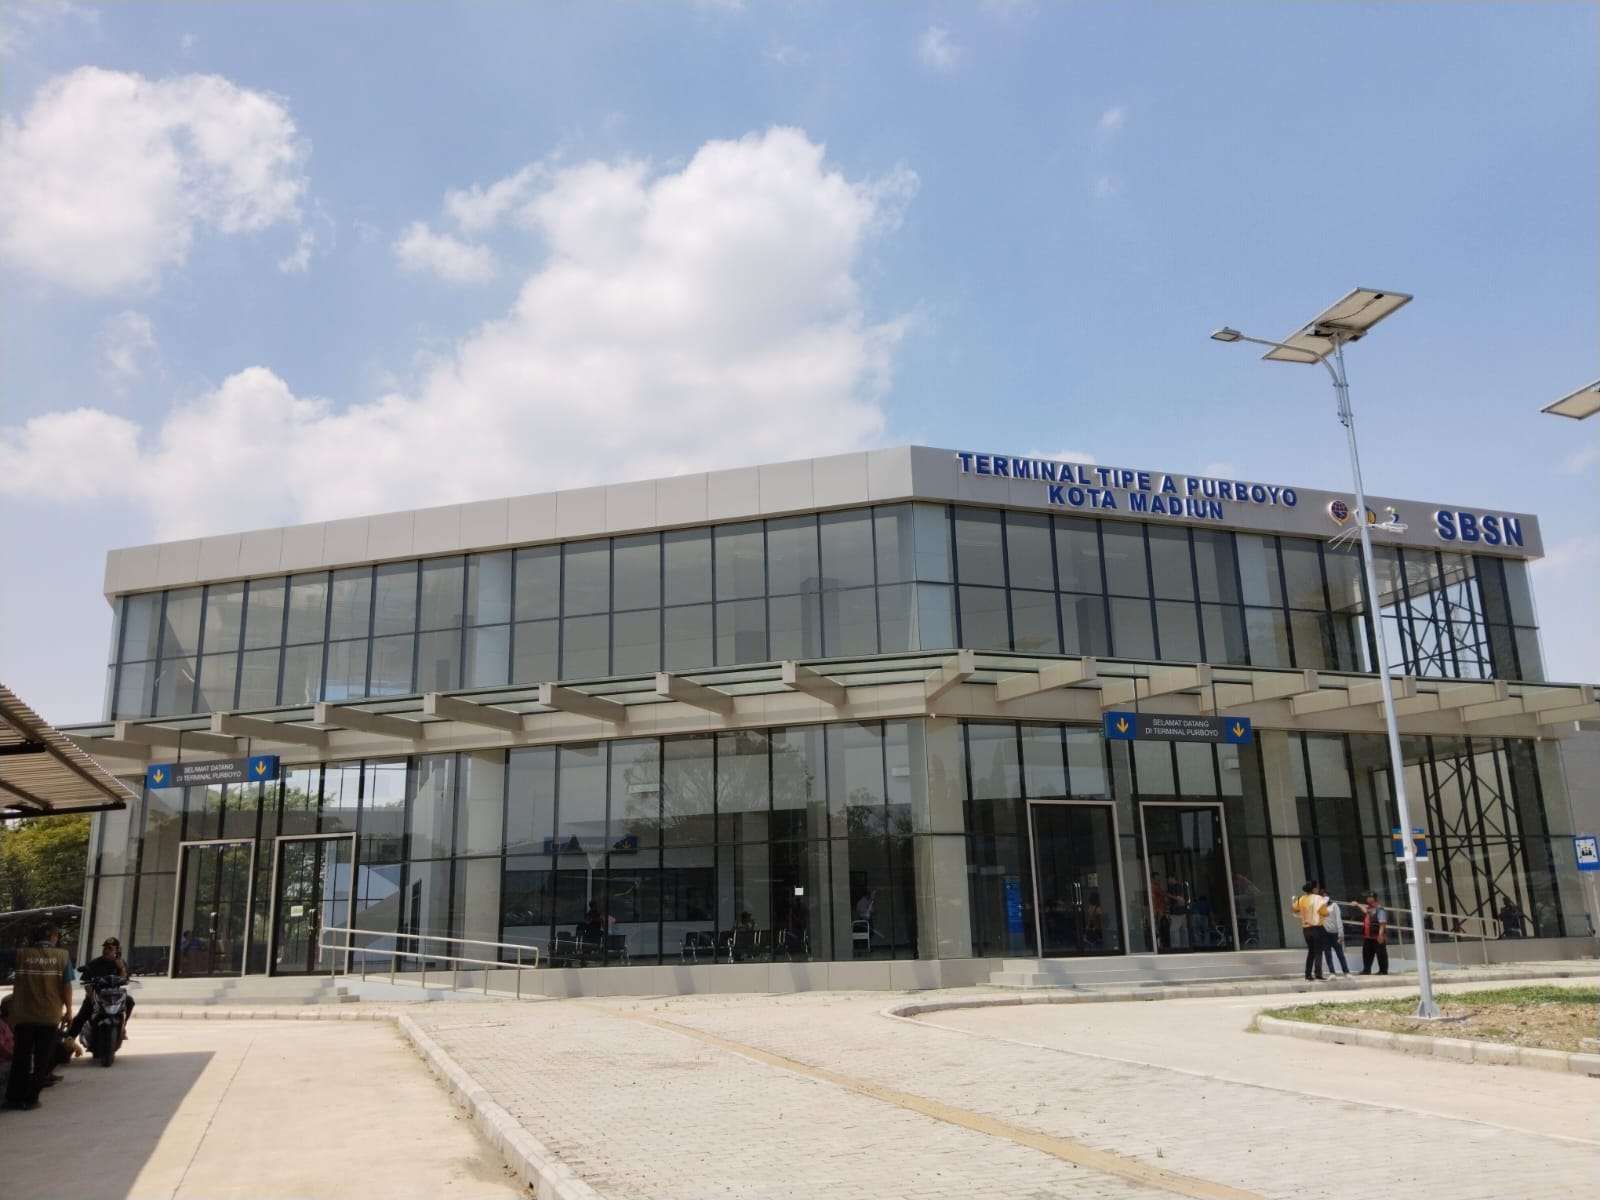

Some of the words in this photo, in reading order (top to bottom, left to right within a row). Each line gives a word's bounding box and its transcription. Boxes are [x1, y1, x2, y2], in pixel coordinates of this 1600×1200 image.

[957, 452, 1091, 485] TERMINAL
[1097, 467, 1151, 491] TIPE
[1160, 475, 1178, 494] A
[1186, 477, 1297, 507] PURBOYO
[1048, 485, 1118, 510] KOTA
[1128, 492, 1224, 520] MADIUN
[1434, 510, 1524, 547] SBSN
[1152, 719, 1182, 727] SELAMAT
[1183, 720, 1209, 728] DATANG
[1154, 728, 1186, 736] TERMINAL
[1187, 729, 1219, 737] PURBOYO
[184, 765, 209, 774] SELAMAT
[210, 763, 234, 772] DATANG
[184, 773, 212, 781] TERMINAL
[213, 771, 242, 779] PURBOYO
